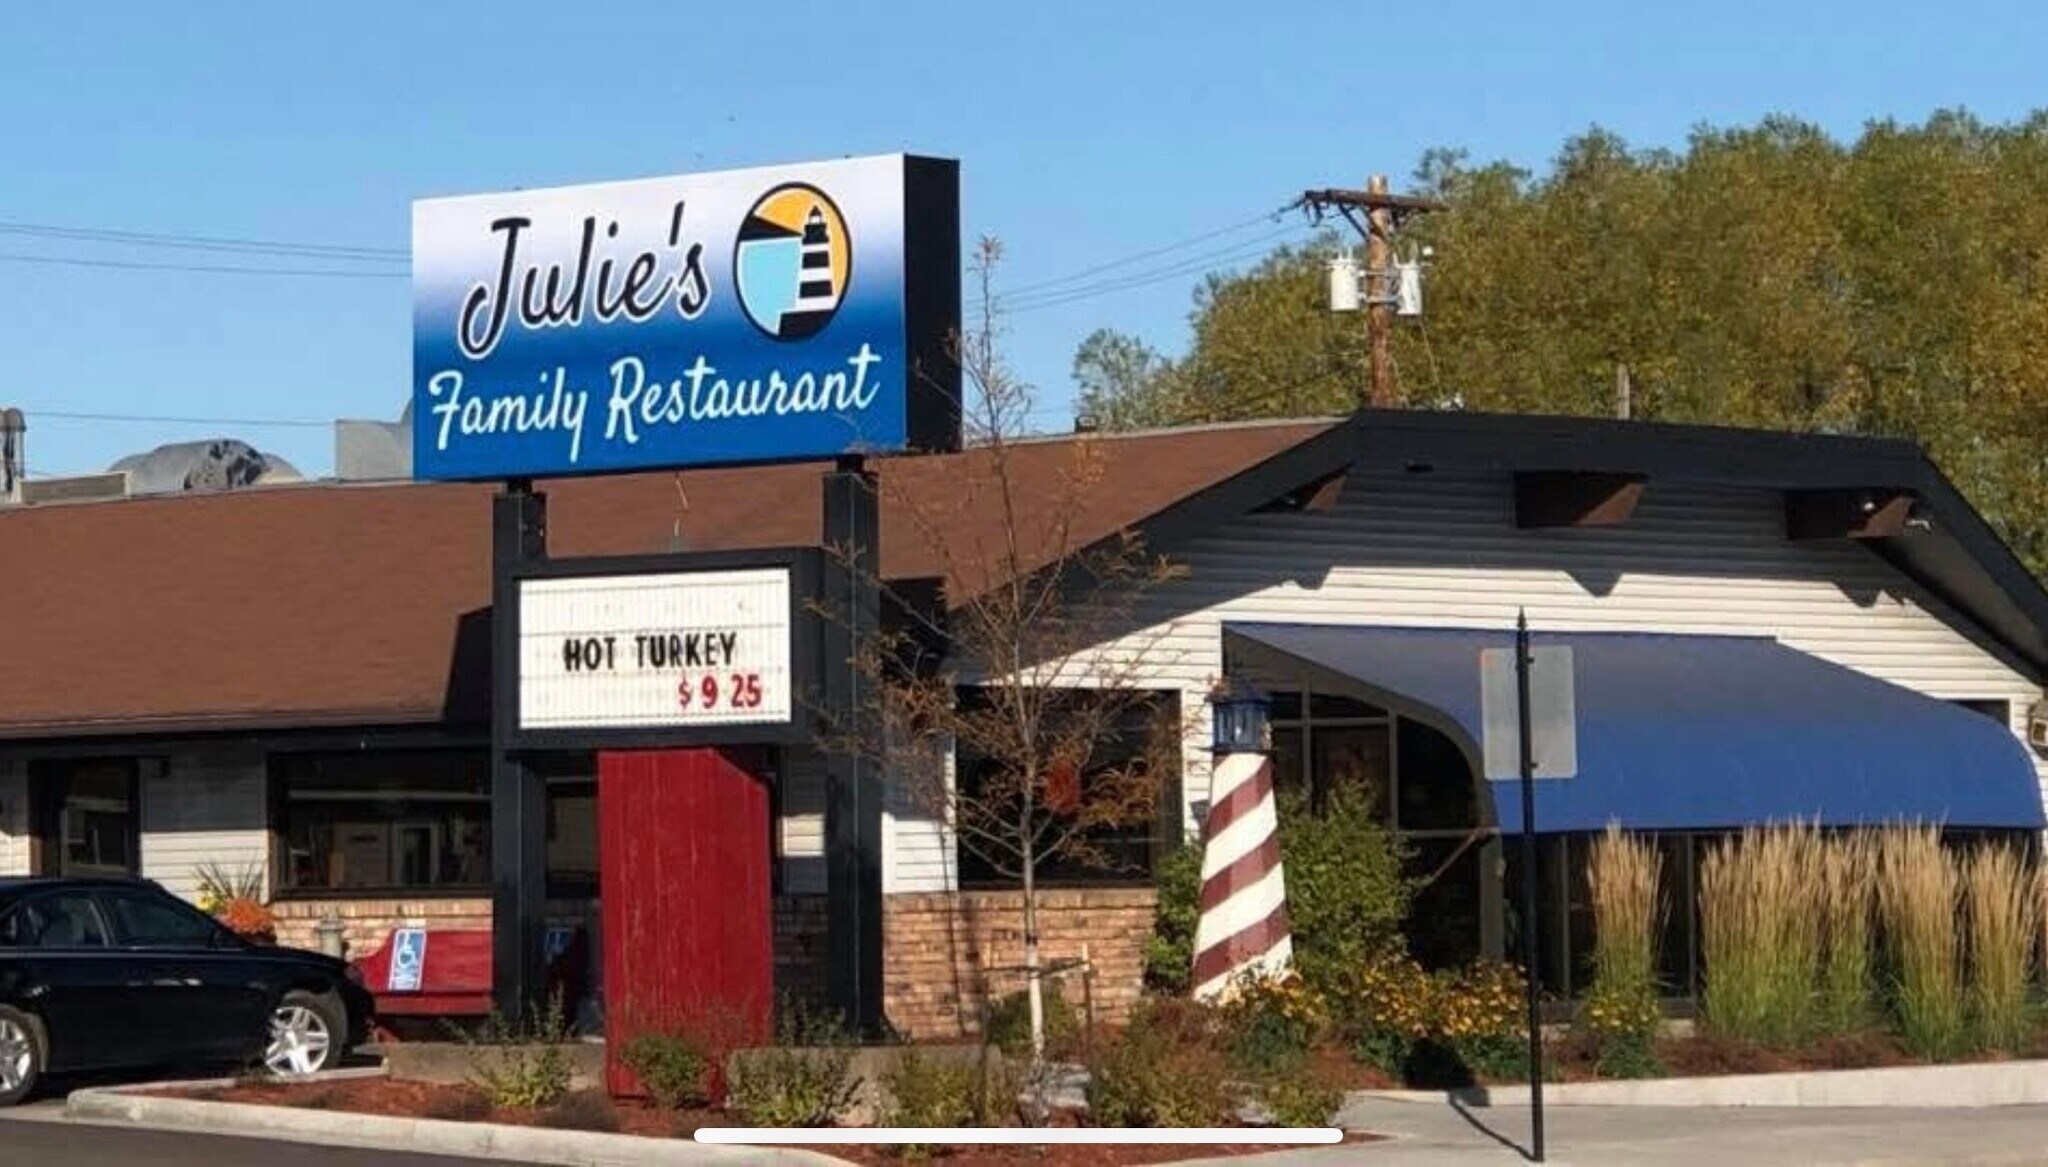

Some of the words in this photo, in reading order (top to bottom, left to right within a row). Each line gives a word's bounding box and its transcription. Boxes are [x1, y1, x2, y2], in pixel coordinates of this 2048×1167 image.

[461, 200, 710, 356] Julie's
[429, 367, 587, 462] Family
[605, 343, 881, 444] Restaurant
[563, 637, 616, 671] HOT
[635, 632, 737, 667] TURKEY
